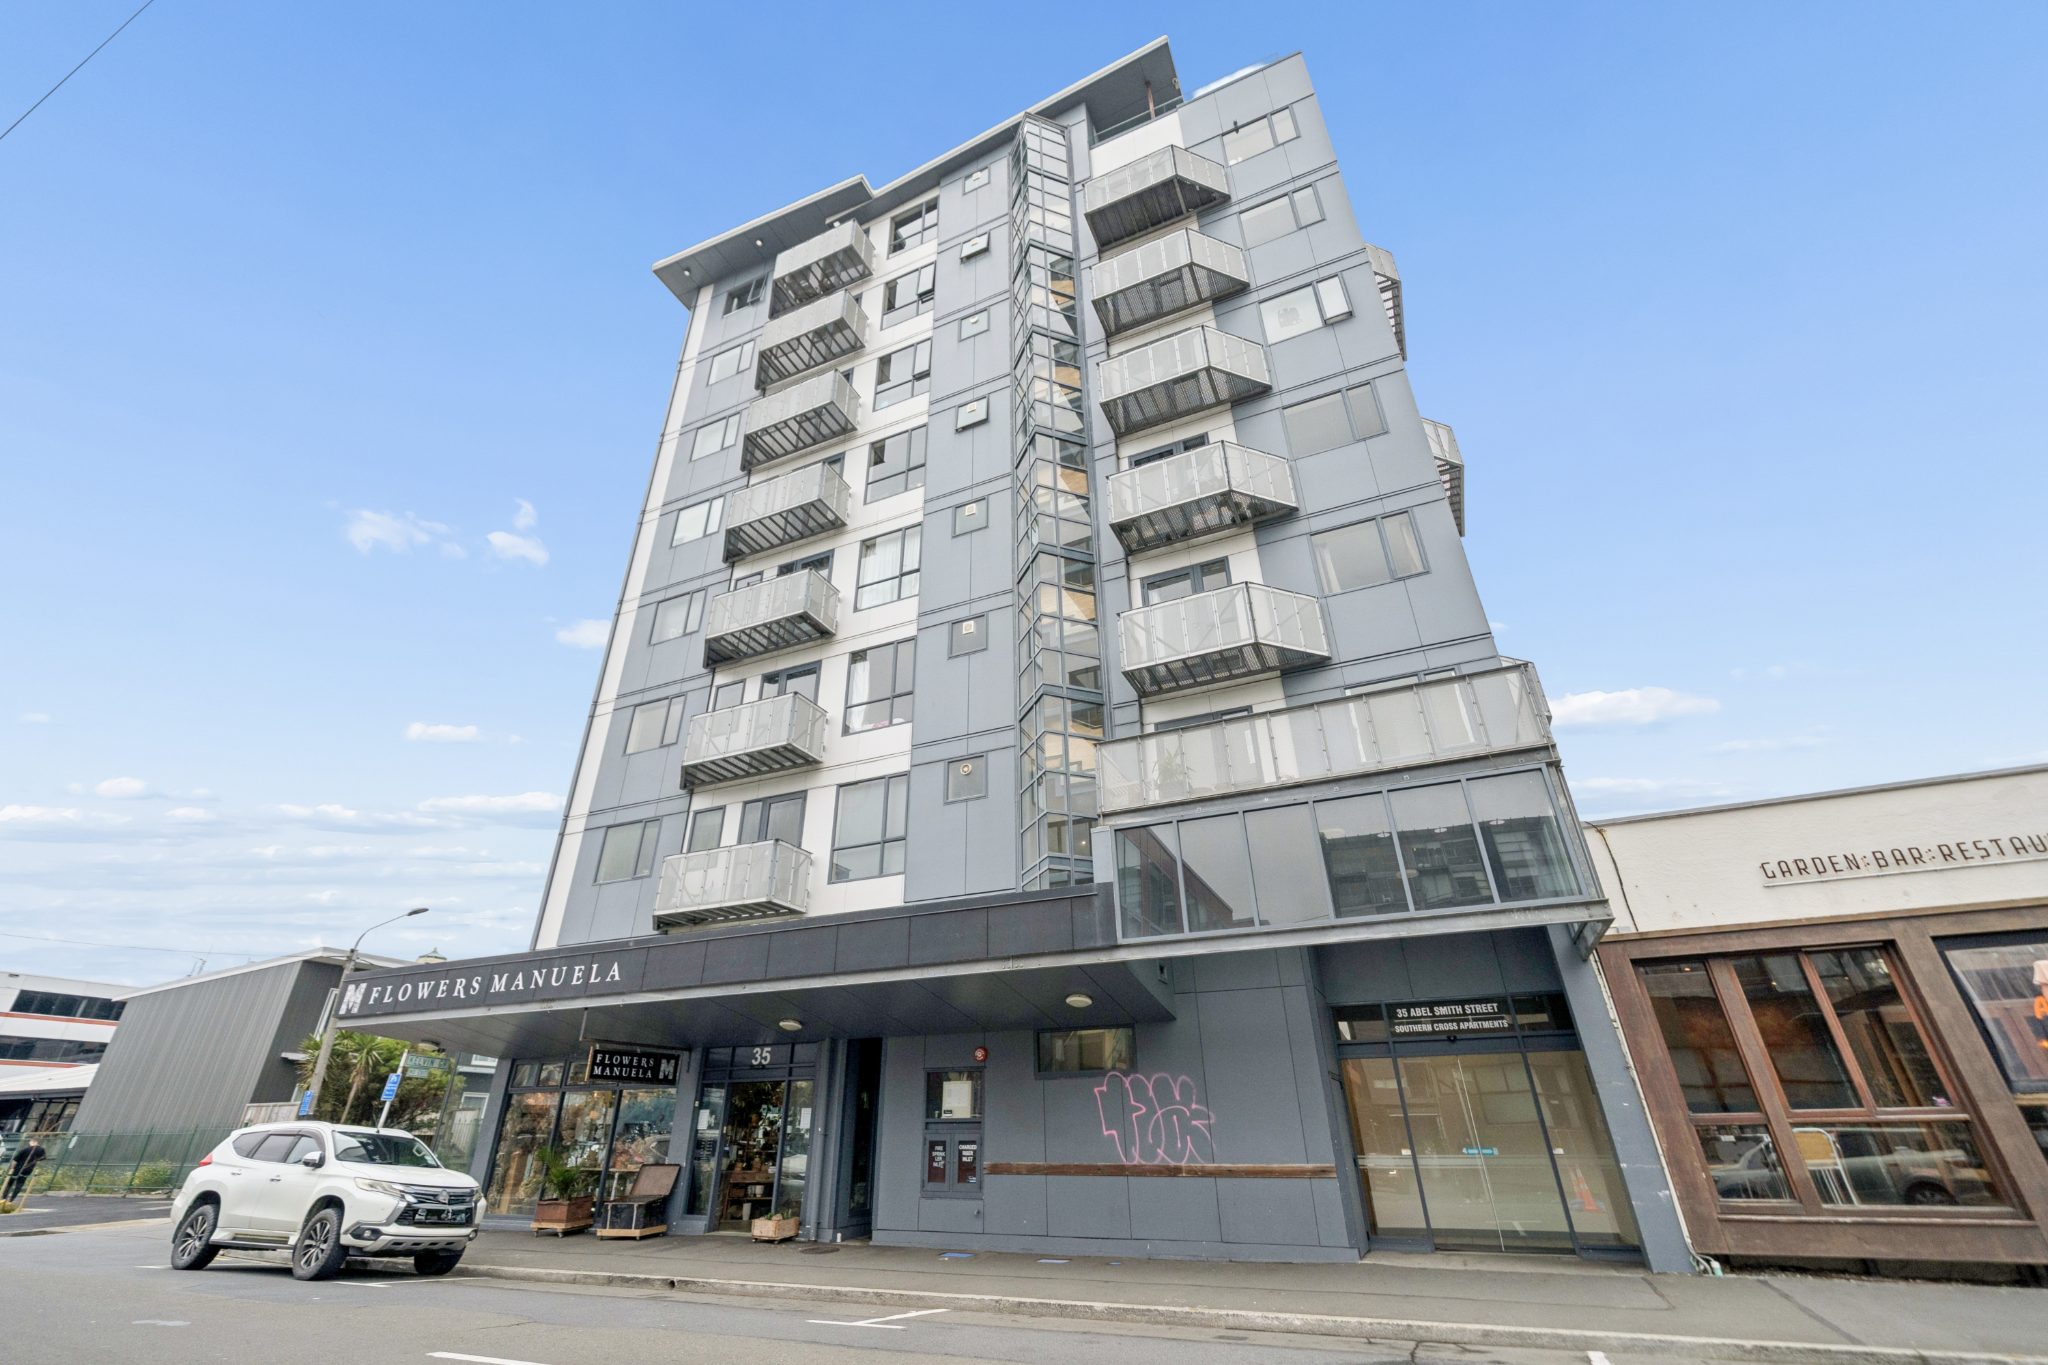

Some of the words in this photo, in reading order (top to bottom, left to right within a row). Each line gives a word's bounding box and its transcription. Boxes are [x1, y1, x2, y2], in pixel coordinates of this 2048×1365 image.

[368, 976, 482, 1005] FLOWERS
[490, 961, 622, 993] MANUELA
[1396, 1008, 1408, 1018] 35
[1410, 1006, 1433, 1017] ABEL
[1434, 1004, 1463, 1016] SMITH
[1464, 1003, 1499, 1014] STREET
[1394, 1023, 1433, 1033] SOUTHERN
[1433, 1021, 1459, 1031] CROSS
[1460, 1019, 1509, 1030] APARTMENTS
[596, 1053, 655, 1068] FLOWERS
[751, 1047, 772, 1065] 35
[593, 1065, 653, 1079] MANUELA
